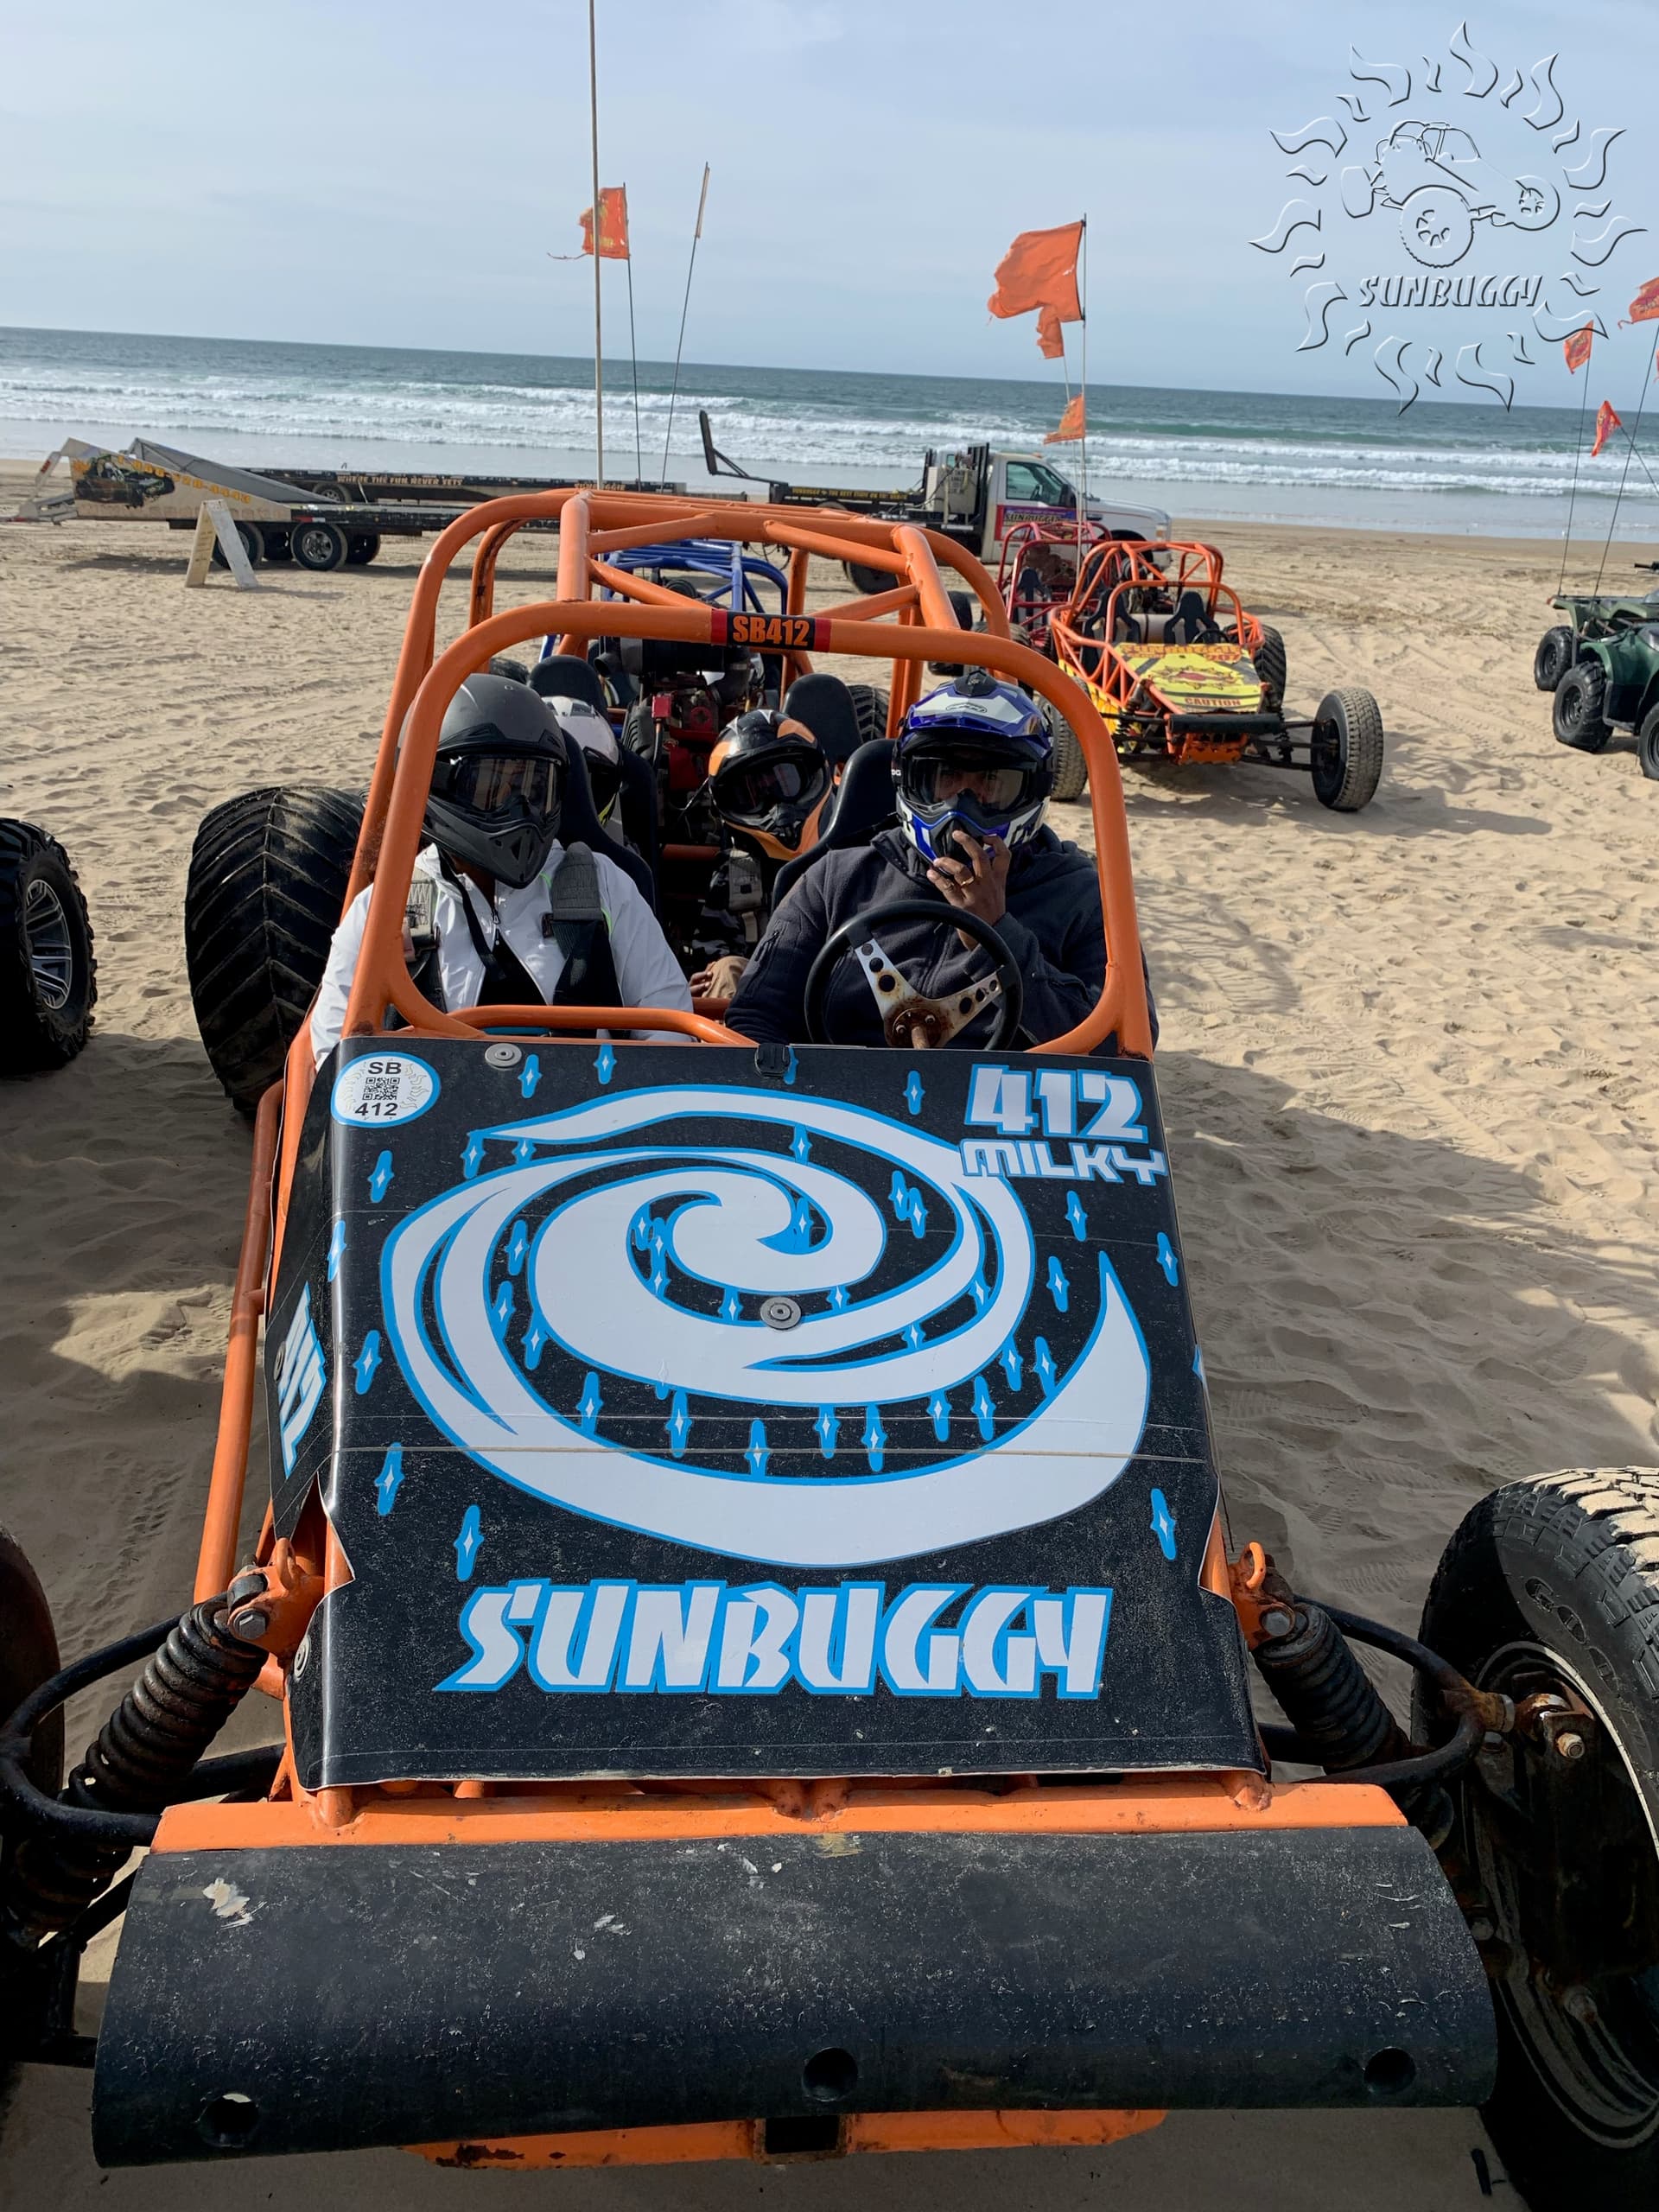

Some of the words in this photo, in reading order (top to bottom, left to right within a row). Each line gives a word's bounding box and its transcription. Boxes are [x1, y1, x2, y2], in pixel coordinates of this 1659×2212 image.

[733, 615, 810, 646] SB412
[1185, 697, 1242, 706] CAUTION
[367, 1061, 402, 1075] SB
[354, 1102, 398, 1116] 412
[965, 1064, 1148, 1143] 412
[960, 1138, 1166, 1186] MILKY
[432, 1578, 1113, 1700] SUNBUGGY
